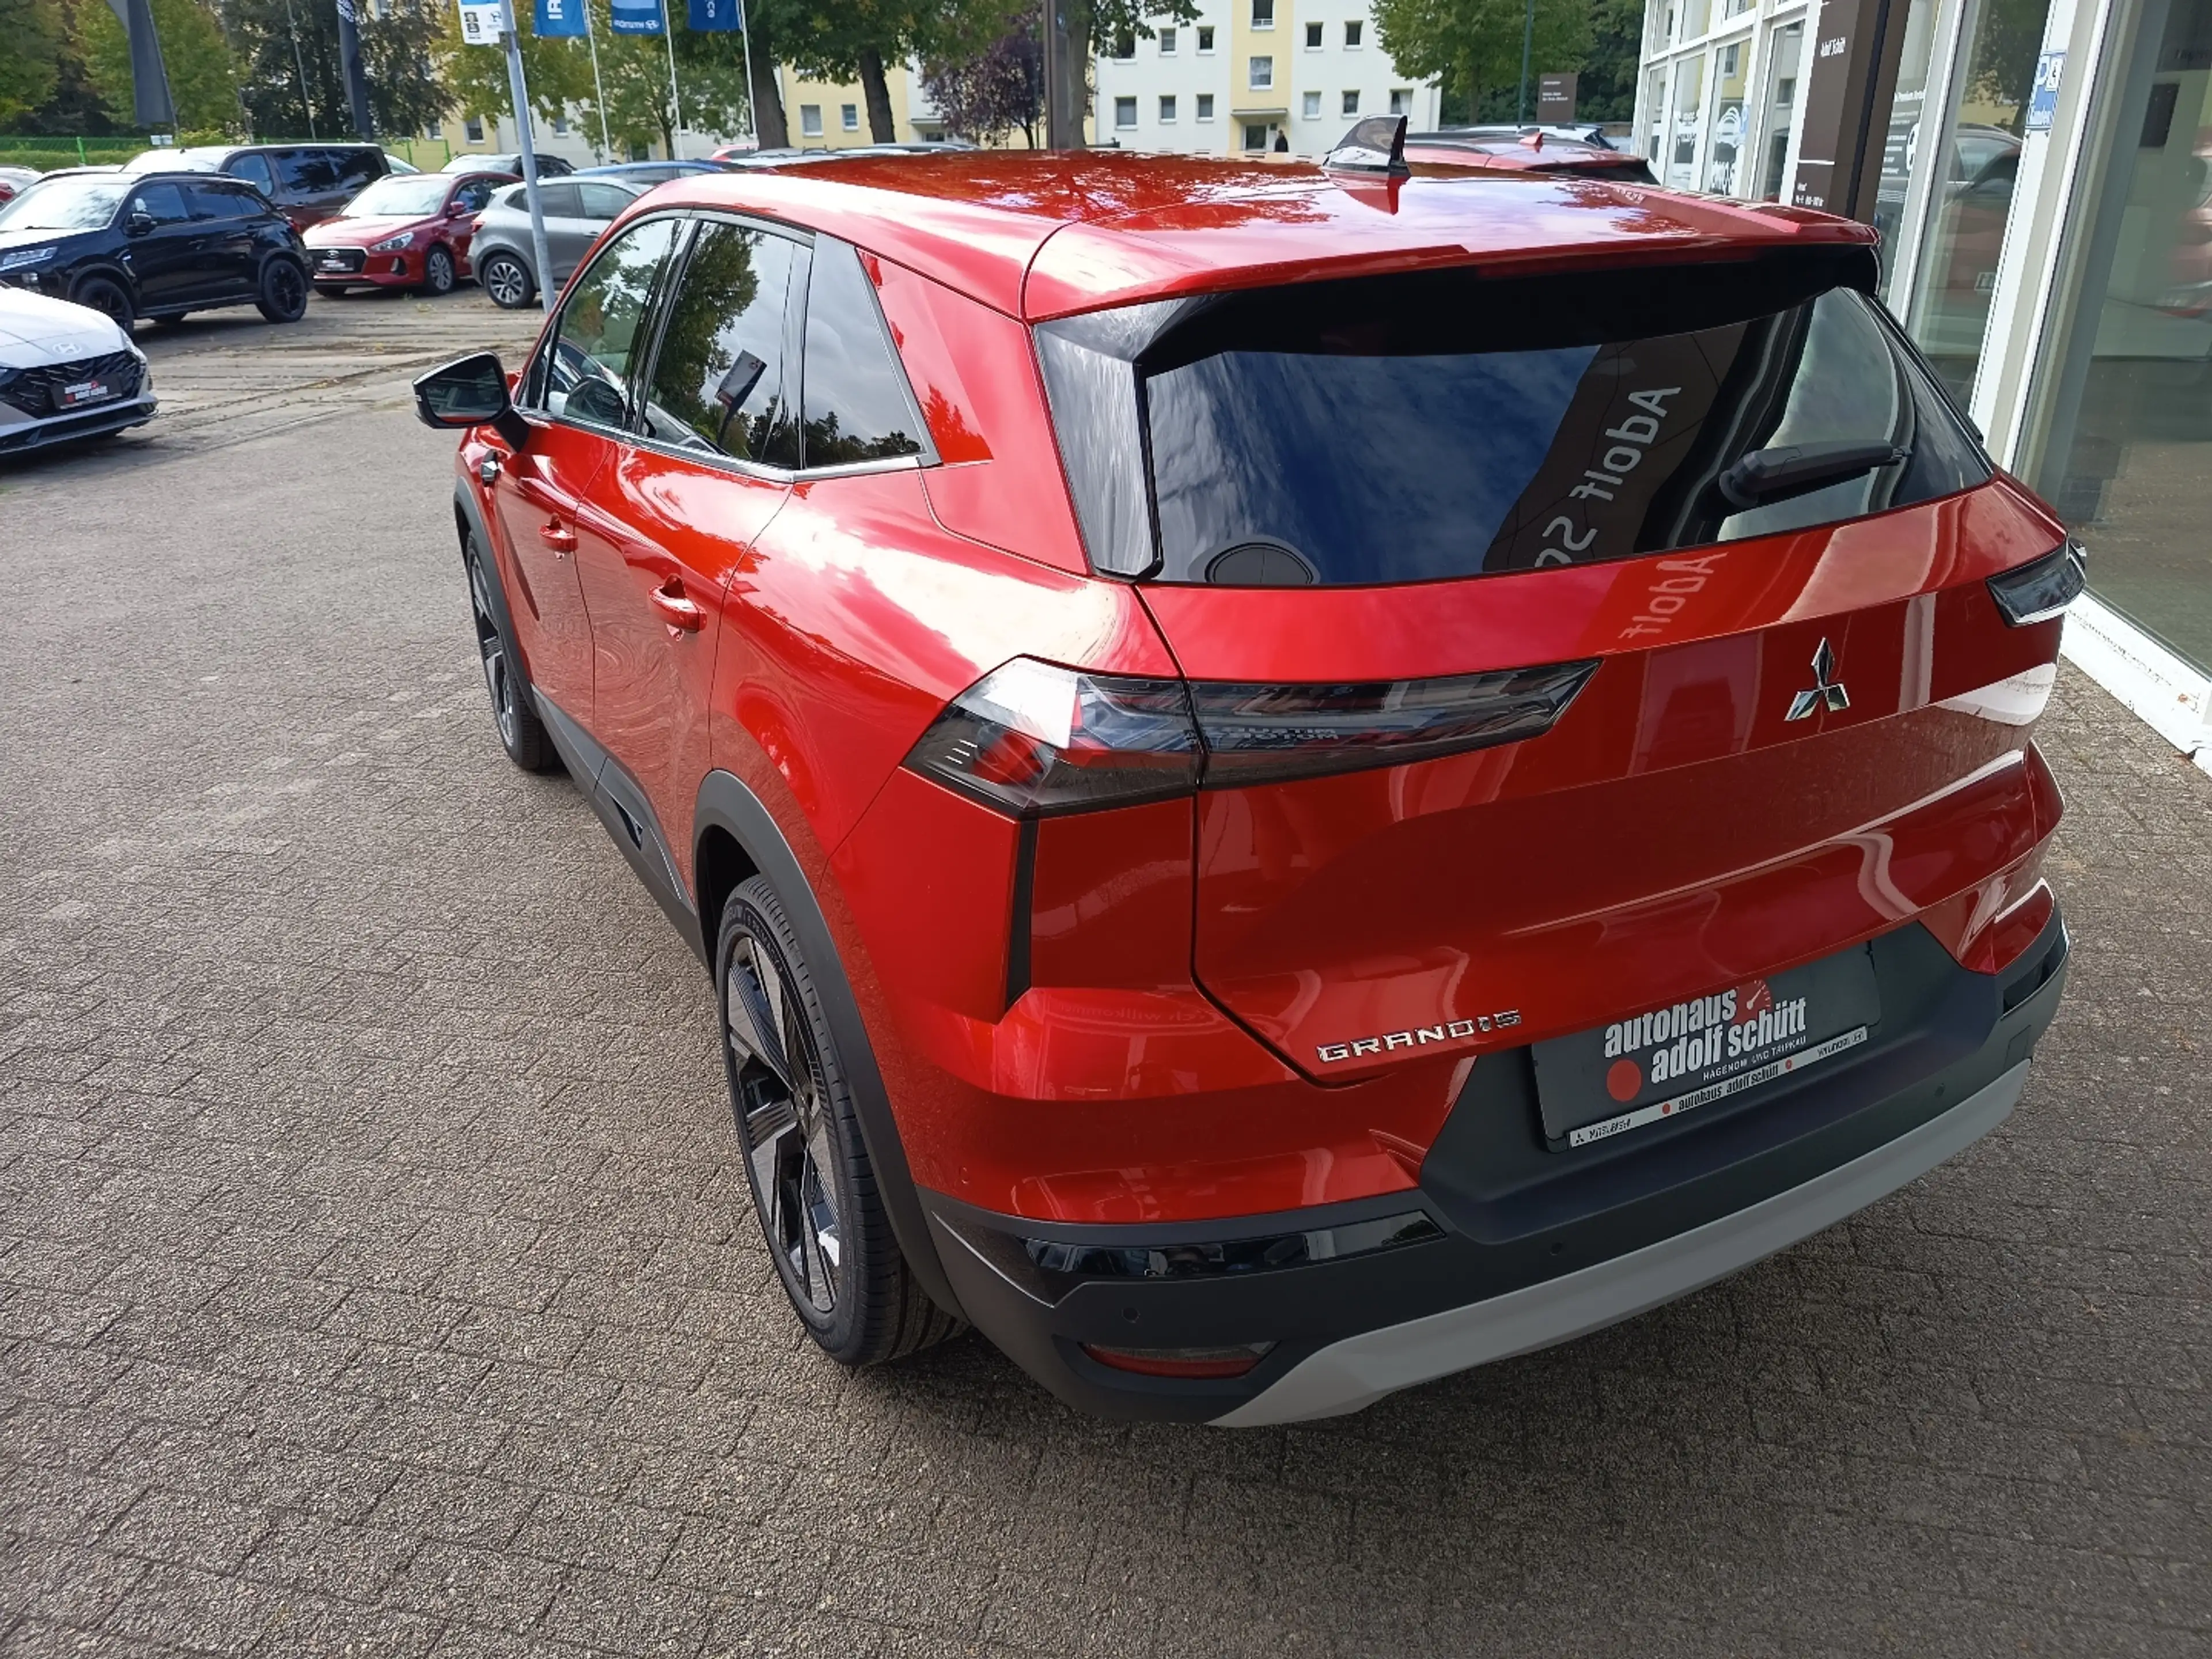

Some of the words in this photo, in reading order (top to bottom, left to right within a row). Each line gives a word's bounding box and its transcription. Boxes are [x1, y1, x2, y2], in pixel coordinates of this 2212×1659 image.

[1317, 1009, 1521, 1063] GRANDIS
[1651, 1024, 1723, 1084] adolf
[1728, 996, 1806, 1058] schütt
[1679, 1086, 1722, 1111] autohaus
[1727, 1073, 1750, 1093] adolf
[1703, 1058, 1748, 1081] HAGENOW
